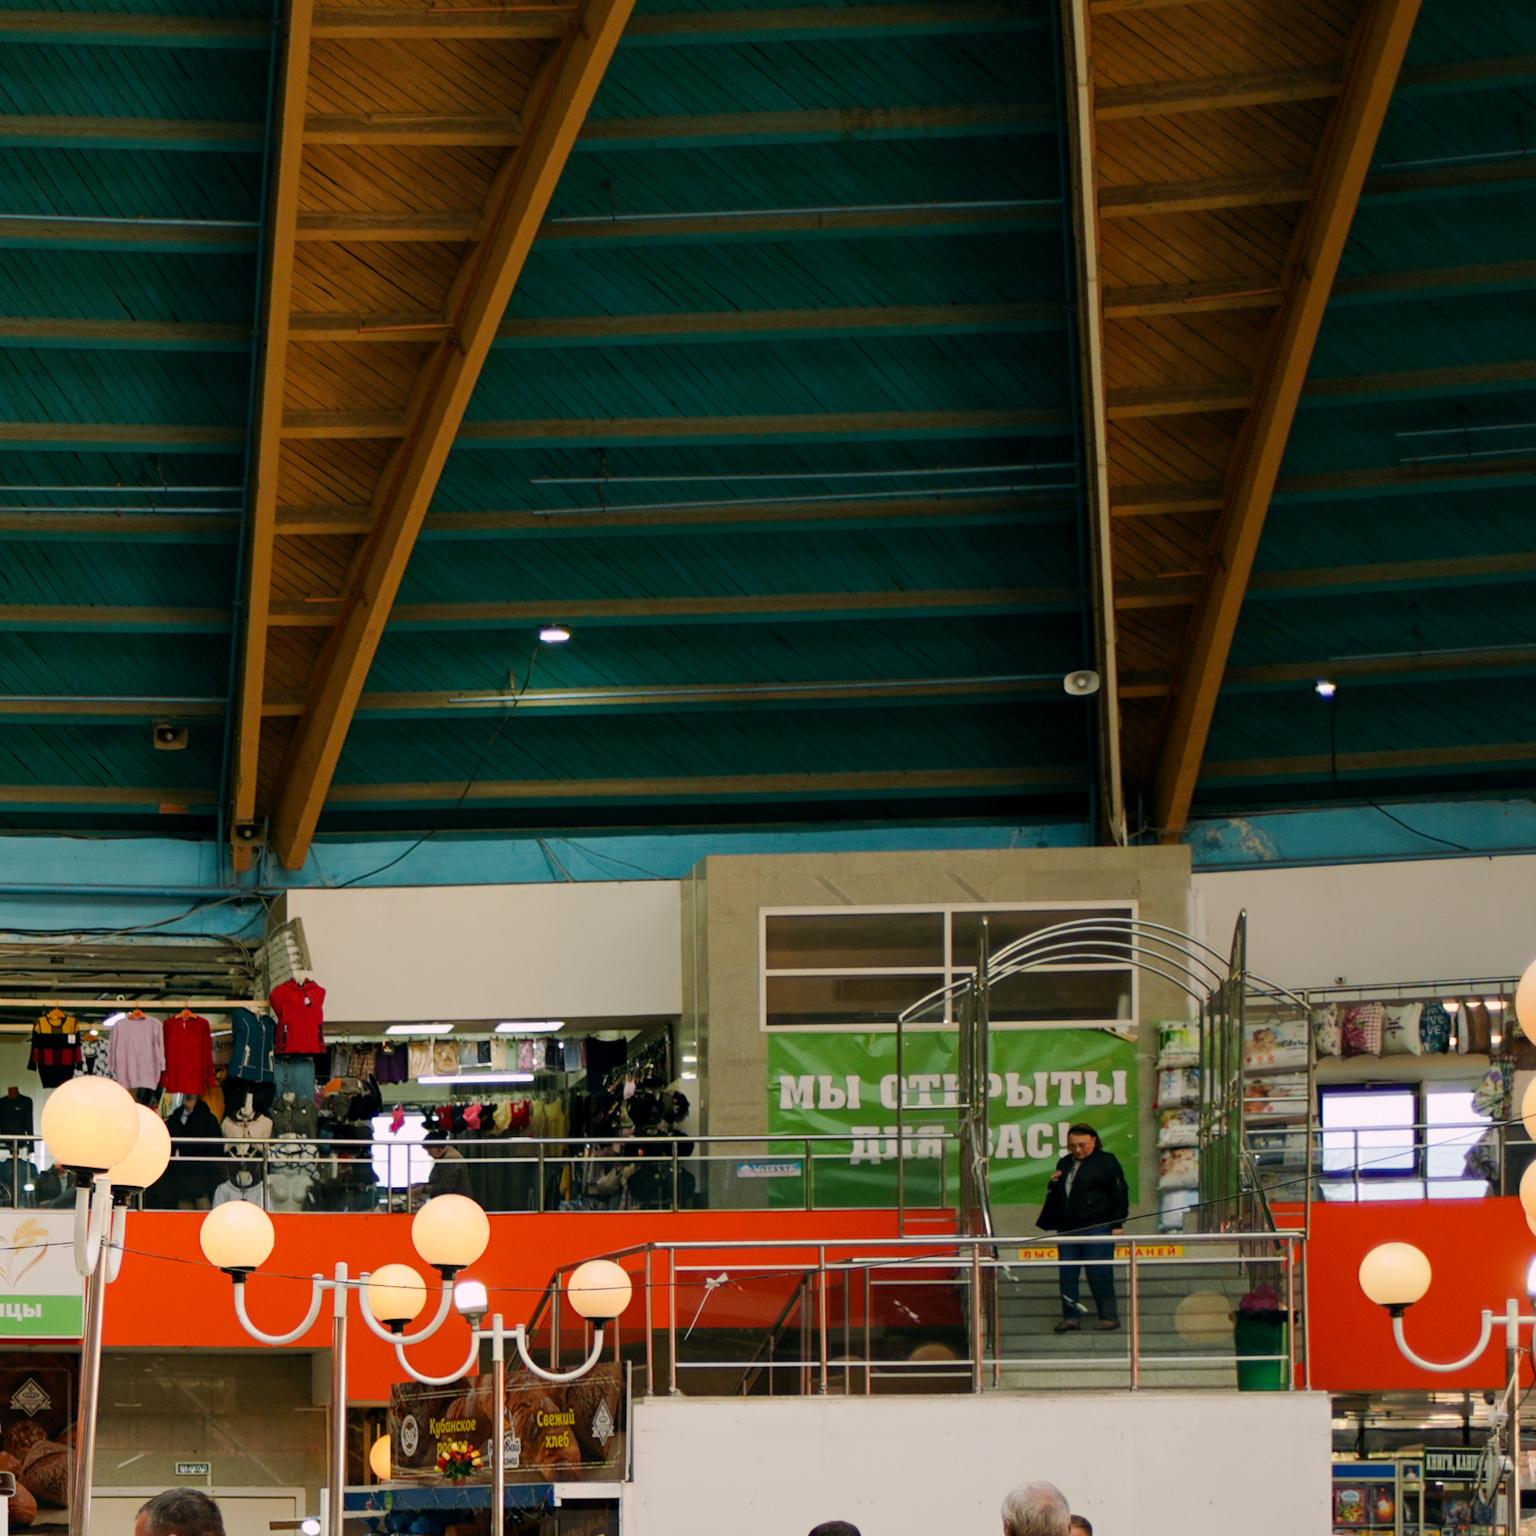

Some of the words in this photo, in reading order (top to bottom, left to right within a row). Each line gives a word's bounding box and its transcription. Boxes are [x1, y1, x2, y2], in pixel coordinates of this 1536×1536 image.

[779, 1074, 860, 1109] МЫ
[850, 1125, 944, 1165] ДЛЯ
[429, 1417, 477, 1439] Кубанское
[536, 1409, 576, 1428] Свежий
[437, 1438, 468, 1457] родое
[545, 1432, 570, 1449] хлеб
